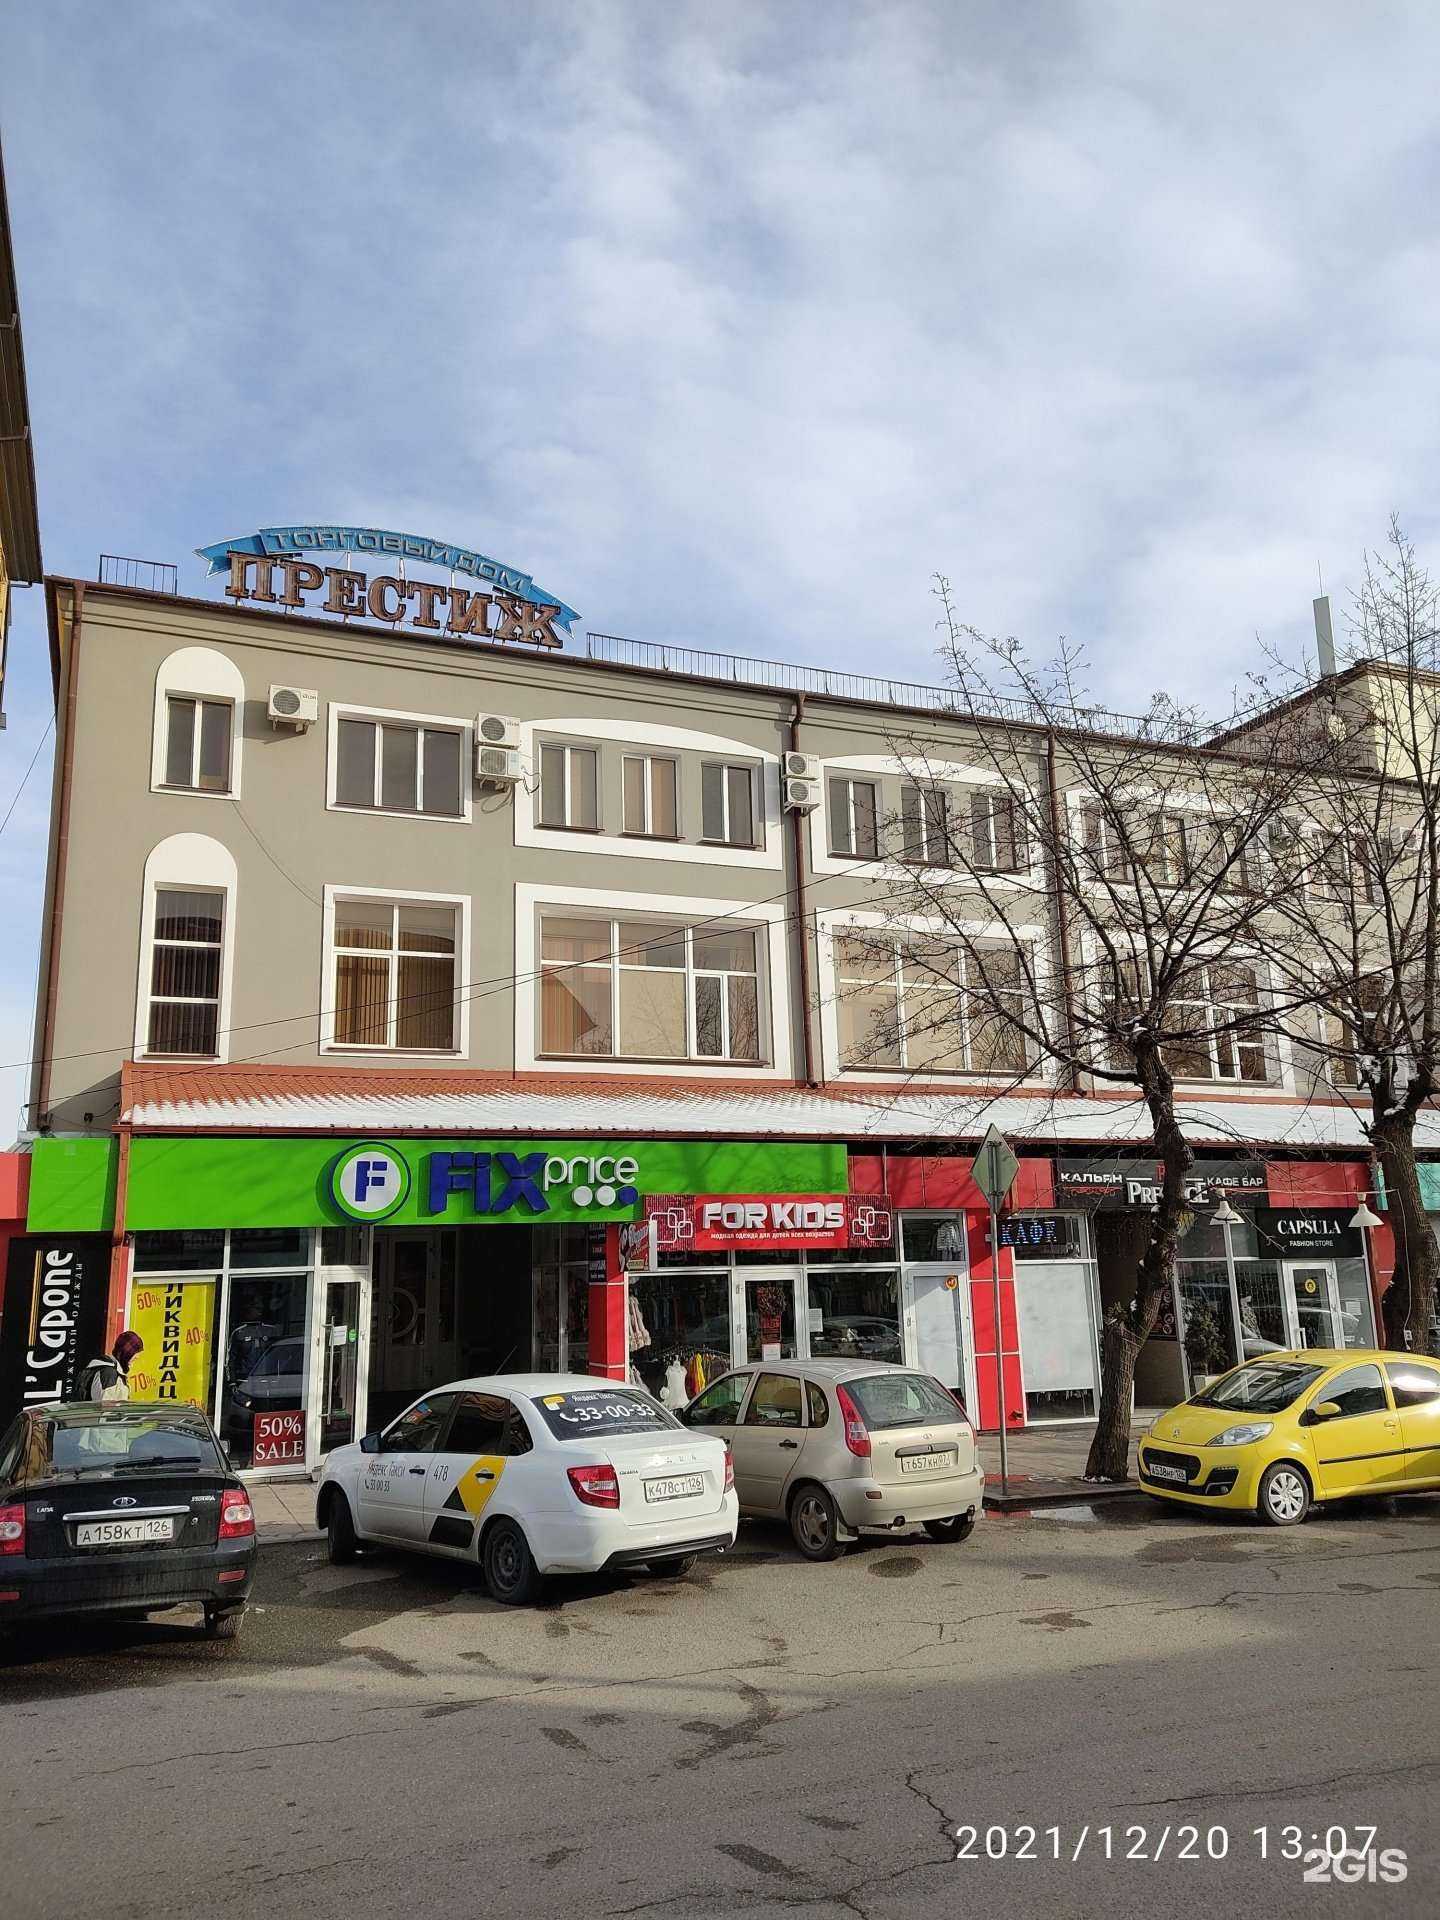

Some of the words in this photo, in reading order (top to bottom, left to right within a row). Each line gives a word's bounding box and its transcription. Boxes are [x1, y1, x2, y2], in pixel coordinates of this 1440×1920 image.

[270, 530, 450, 564] ТОРГОВЫЙ
[455, 554, 524, 592] ДОМ
[225, 550, 563, 649] ПРЕСТИЖ
[543, 1156, 639, 1191] price
[1060, 1172, 1123, 1184] КАЛЬЯН
[1206, 1177, 1240, 1187] КАФЕ
[1242, 1177, 1264, 1187] БАР
[1127, 1182, 1210, 1204] PREGE
[703, 1202, 768, 1229] FOR
[771, 1202, 845, 1229] KIDS
[1277, 1219, 1341, 1234] CAPSULA
[137, 1292, 161, 1310] 50%
[130, 1373, 157, 1392] 70%
[575, 1404, 656, 1421] 33-00-33
[259, 1416, 301, 1438] 50%
[255, 1440, 304, 1460] SALE
[433, 1465, 449, 1481] 478
[688, 1477, 701, 1488] 126
[147, 1521, 168, 1532] 126
